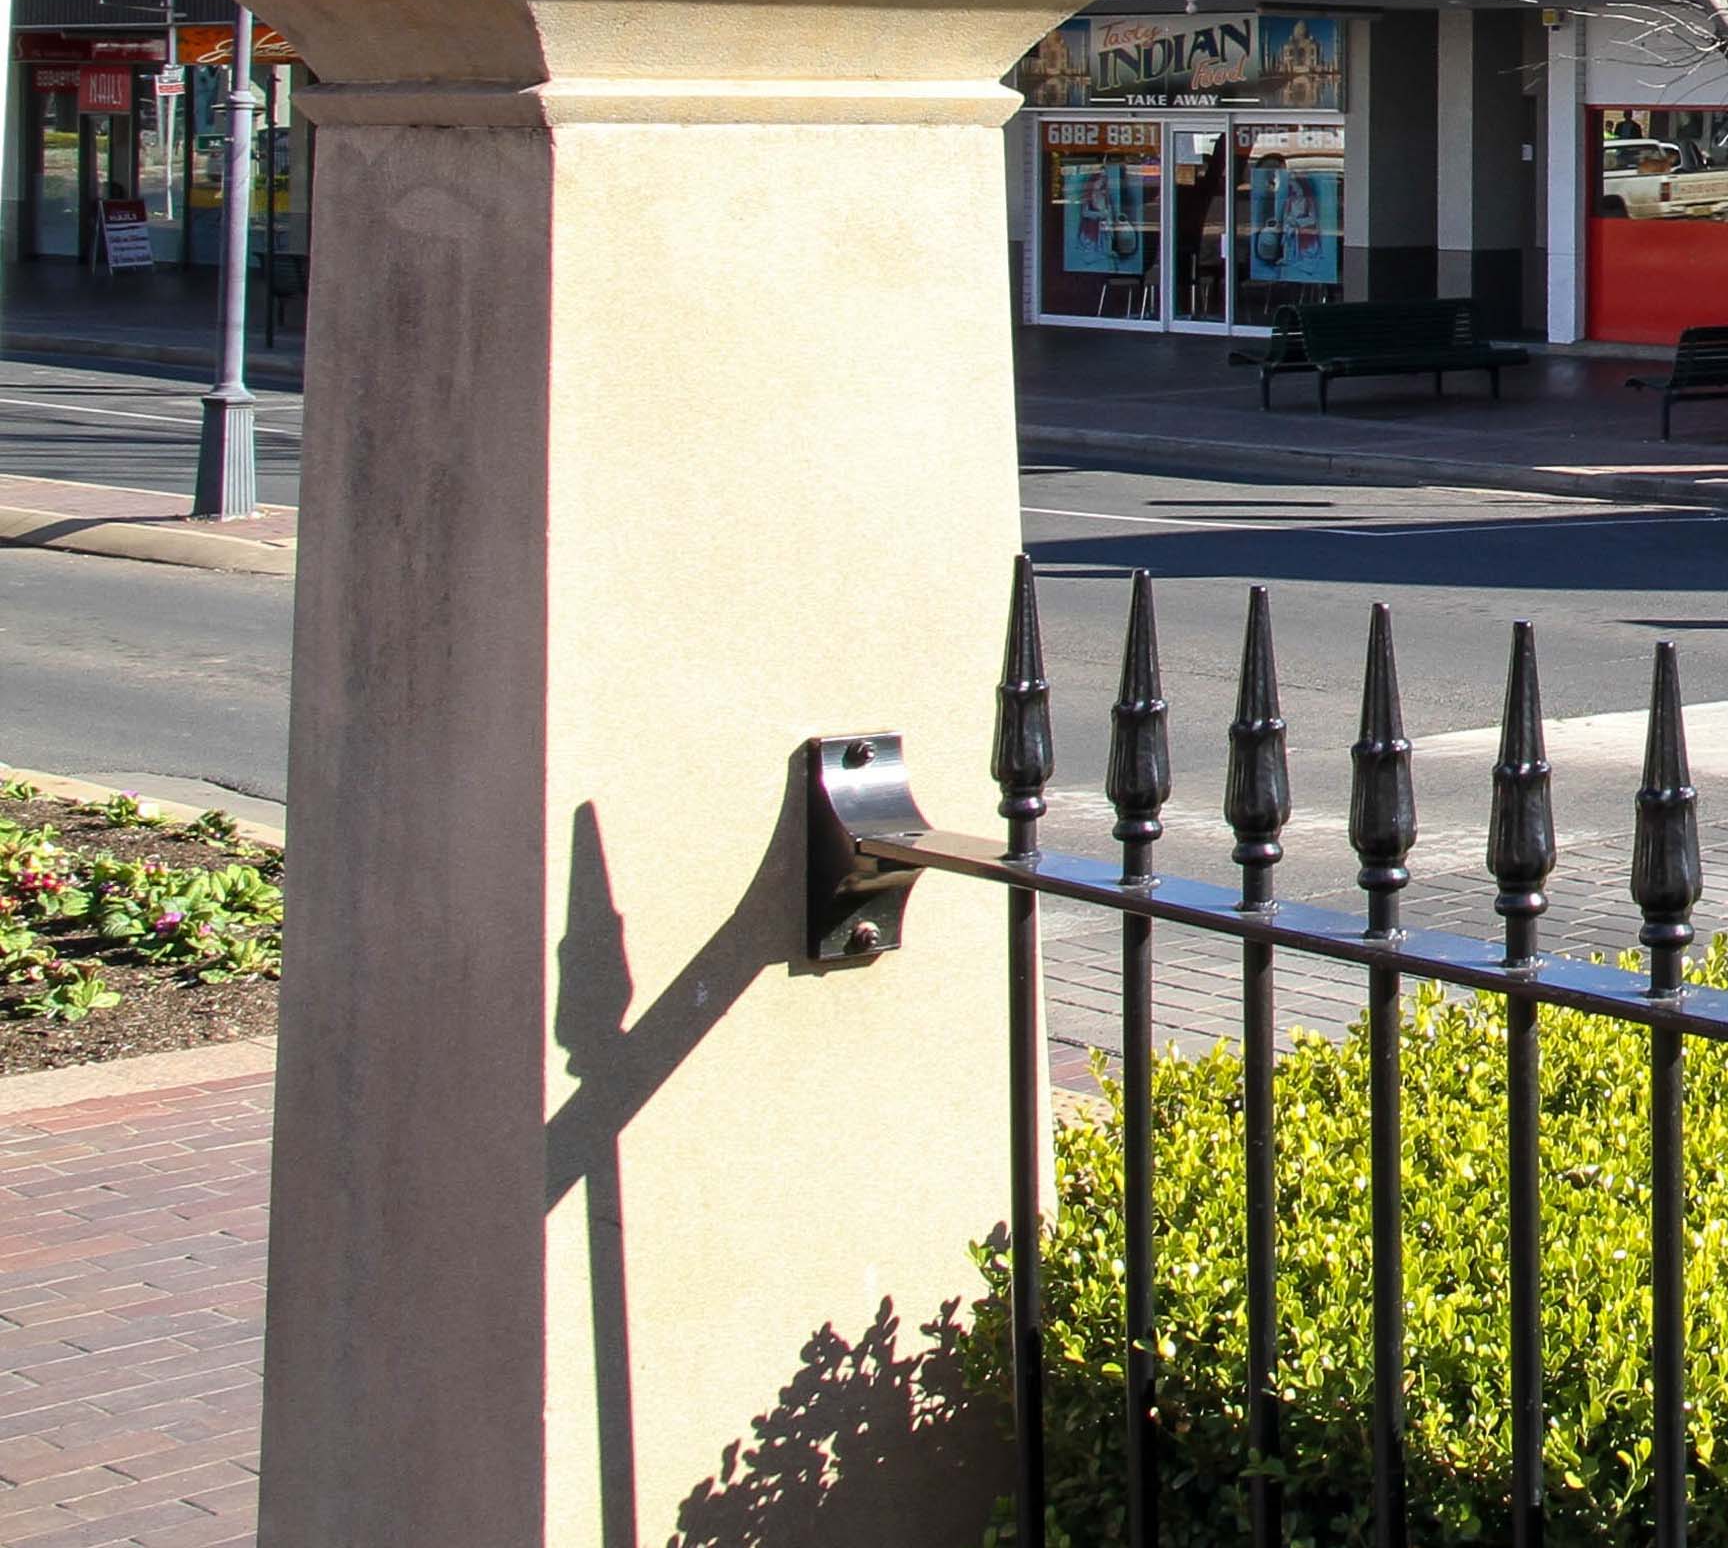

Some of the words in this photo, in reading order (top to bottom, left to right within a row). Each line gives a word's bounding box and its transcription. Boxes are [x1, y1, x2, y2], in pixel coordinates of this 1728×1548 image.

[1098, 19, 1161, 48] Tasty
[1097, 18, 1251, 91] INDIAN
[1191, 54, 1248, 91] Food
[1126, 94, 1167, 106] TAKE
[1173, 94, 1219, 106] AWAY
[1048, 123, 1100, 146] 6882
